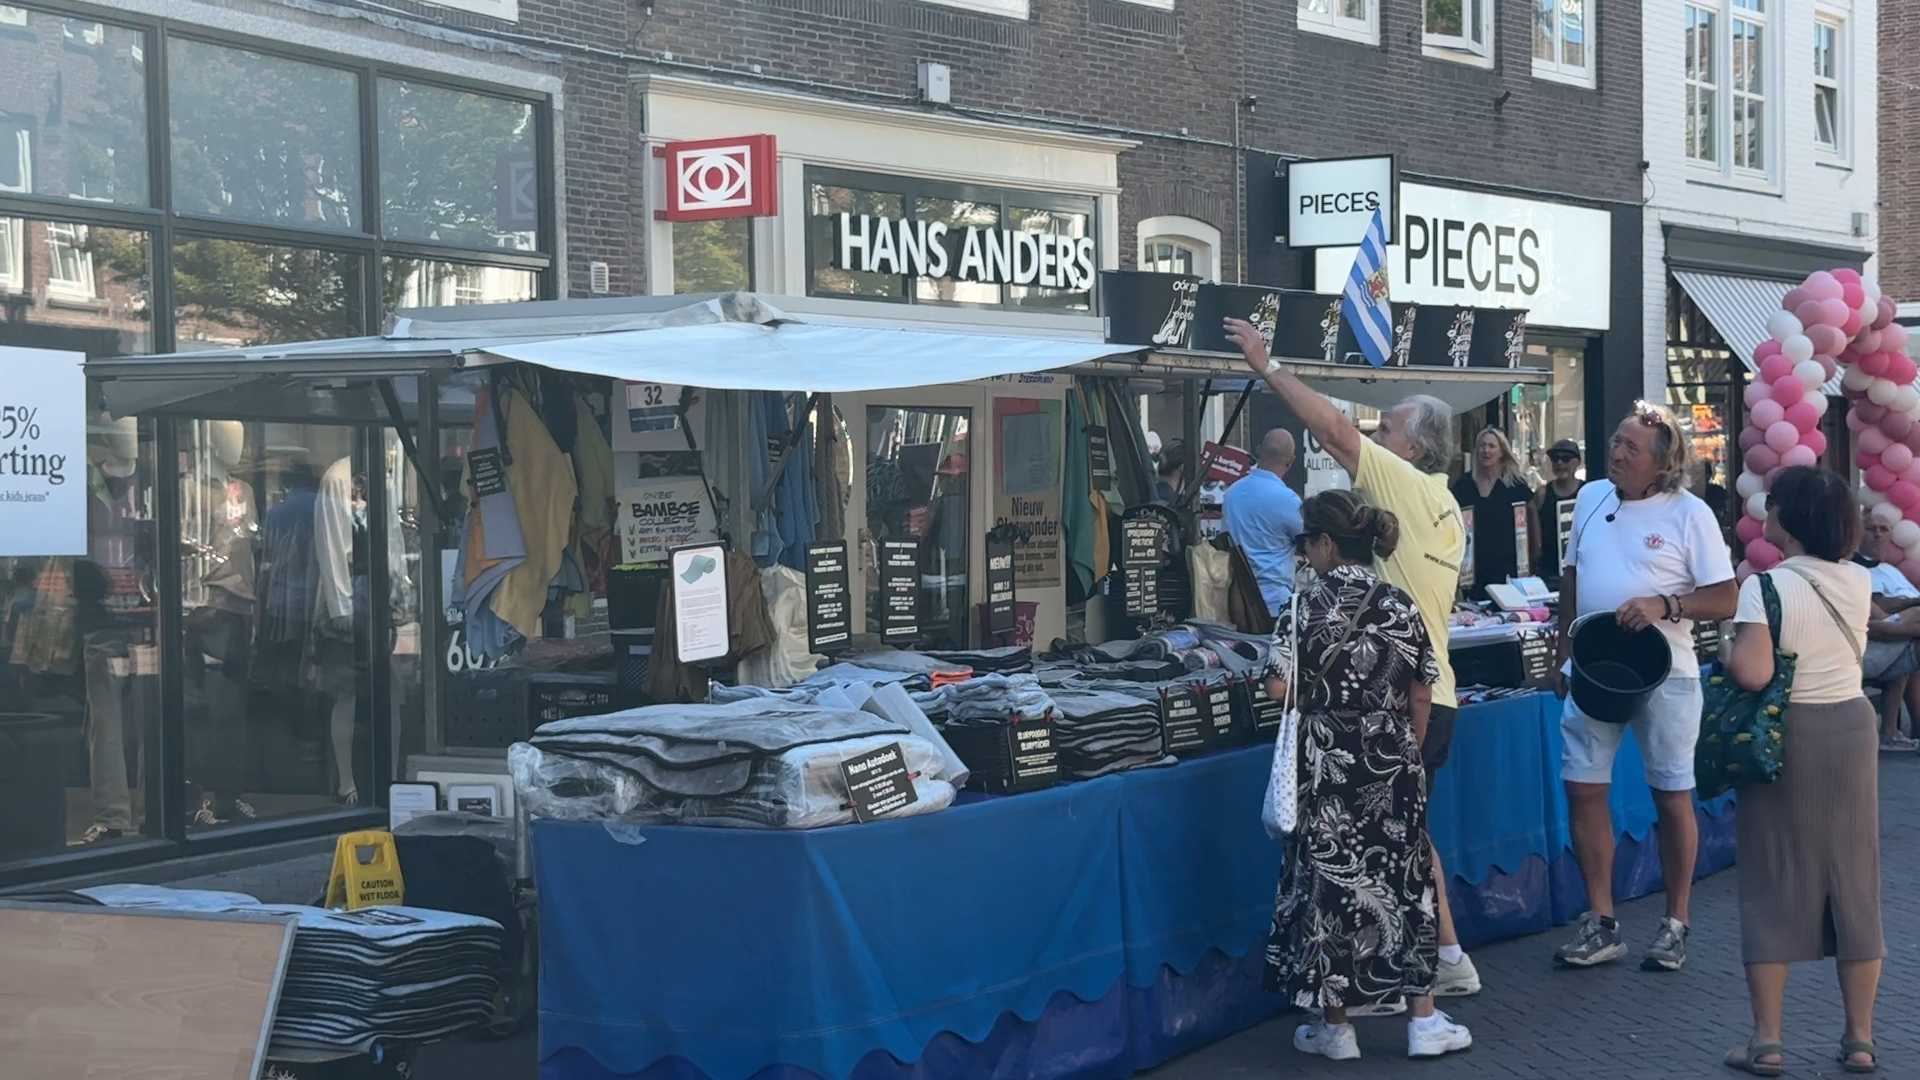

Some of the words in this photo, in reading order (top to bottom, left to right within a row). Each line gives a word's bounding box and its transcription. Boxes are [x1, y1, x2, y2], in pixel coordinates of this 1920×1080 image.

[1300, 190, 1379, 216] PIECES
[840, 212, 949, 278] HANS
[960, 227, 1095, 290] ANDERS
[1405, 215, 1540, 296] PIECES
[644, 385, 663, 406] 32
[0, 406, 40, 440] 5%
[1306, 458, 1320, 471] ALL
[1011, 497, 1045, 516] Nieuw
[997, 517, 1058, 536] wonder
[847, 762, 868, 775] Nano
[867, 749, 898, 768] Autodoek
[361, 879, 395, 890] CAUTION
[359, 891, 376, 901] WET
[376, 890, 400, 901] FLOOR
